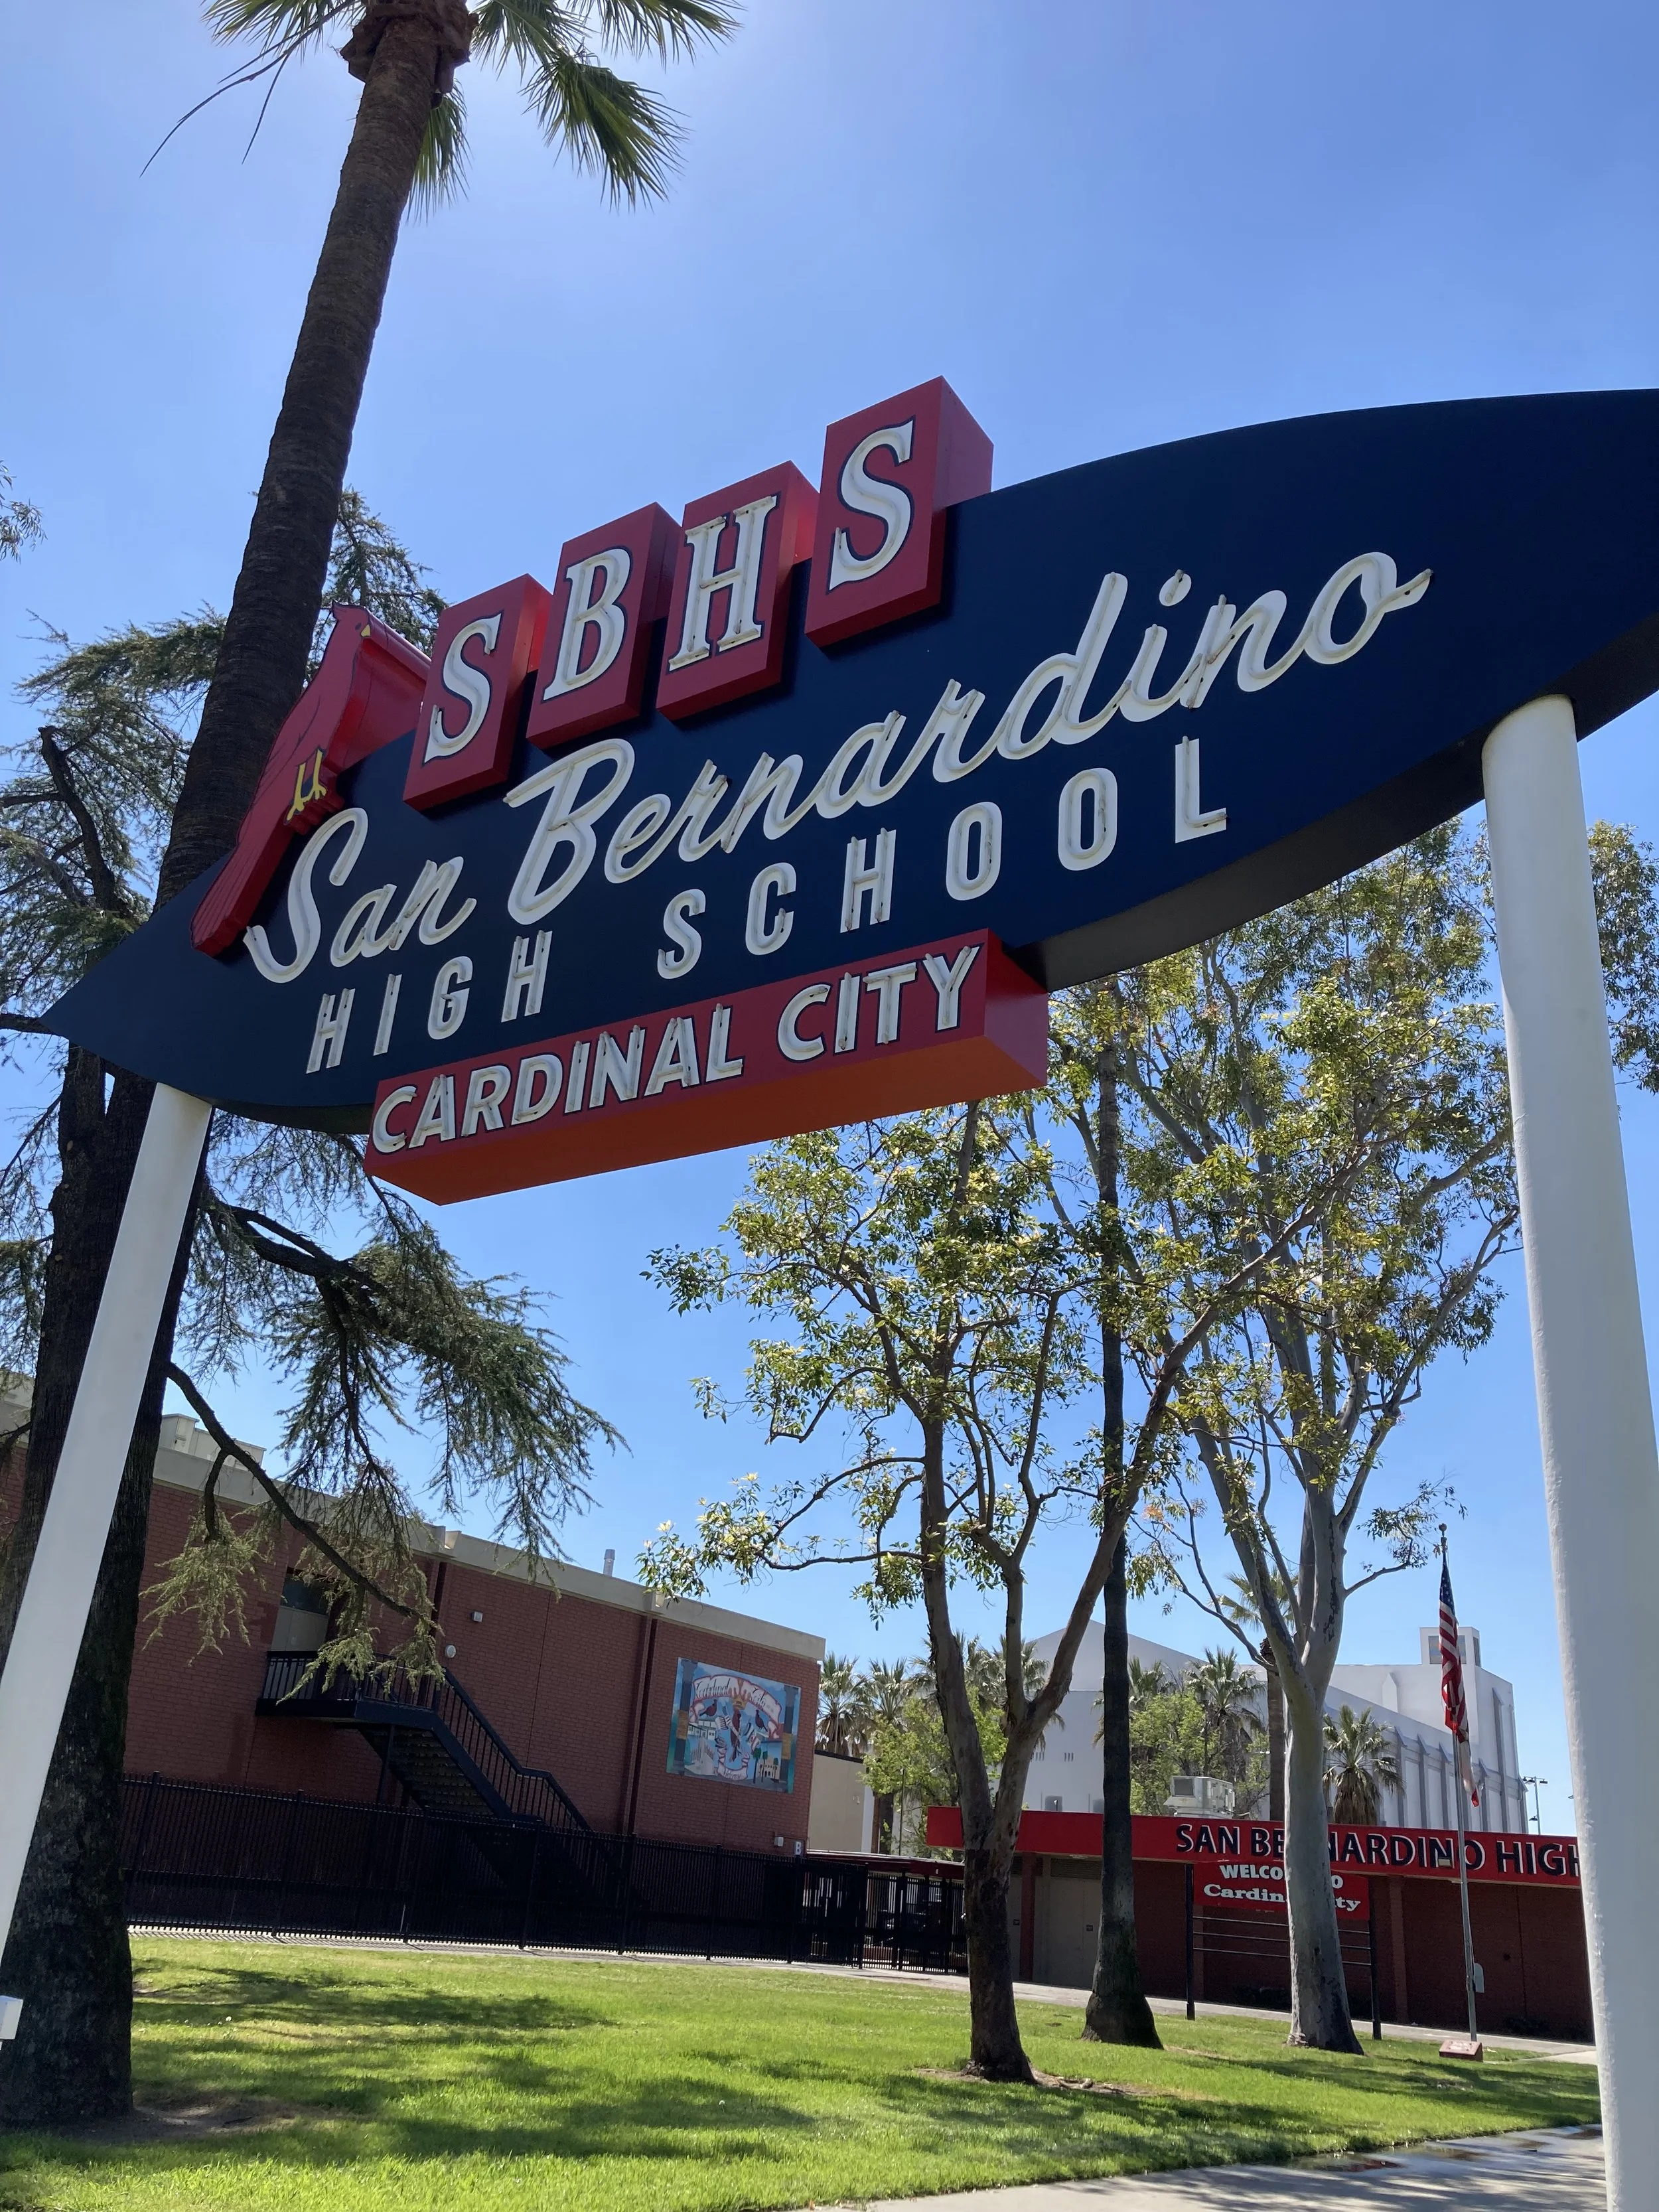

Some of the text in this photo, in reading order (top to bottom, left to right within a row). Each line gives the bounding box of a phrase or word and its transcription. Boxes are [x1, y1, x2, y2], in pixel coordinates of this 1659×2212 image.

[423, 417, 916, 765] SBHS
[244, 552, 1433, 984] San Bernardino
[306, 735, 1228, 1074] HIGH SCHOOL
[372, 945, 982, 1153] CARDINAL CITY
[1177, 1823, 1240, 1855] SAN
[1251, 1826, 1484, 1871] BENARDINO
[1203, 1883, 1361, 1912] Cardin ty
[1219, 1864, 1284, 1880] WELCO
